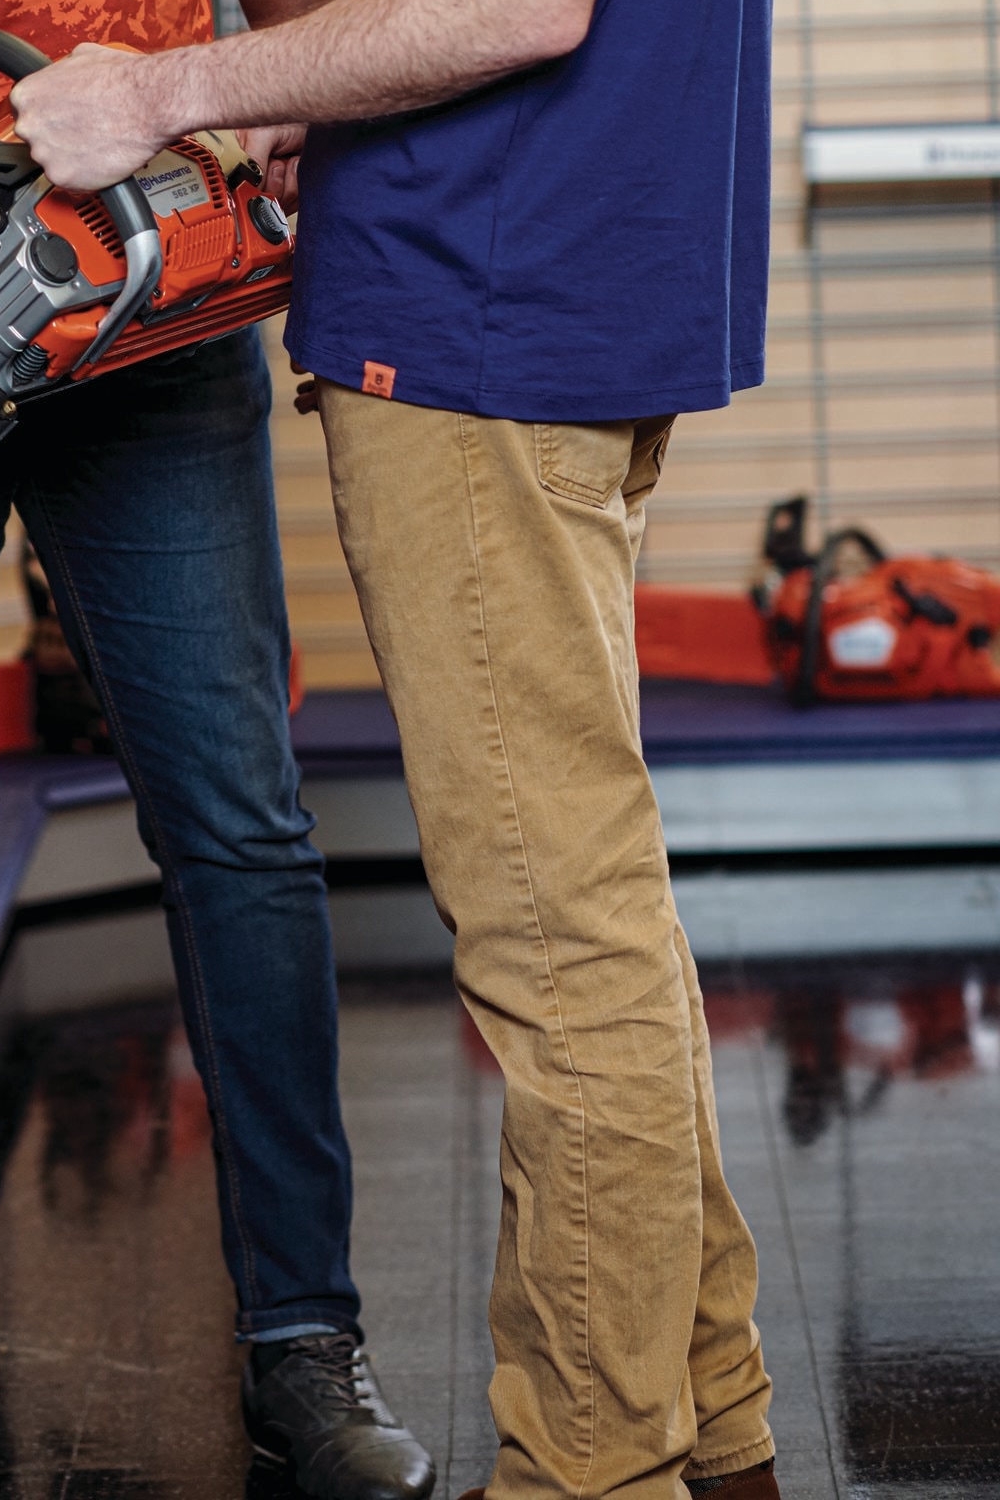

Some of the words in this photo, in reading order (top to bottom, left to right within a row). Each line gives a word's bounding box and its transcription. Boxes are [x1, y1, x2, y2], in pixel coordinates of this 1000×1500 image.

[149, 165, 193, 187] Husqvarna
[171, 187, 189, 199] 562
[188, 183, 200, 194] XP
